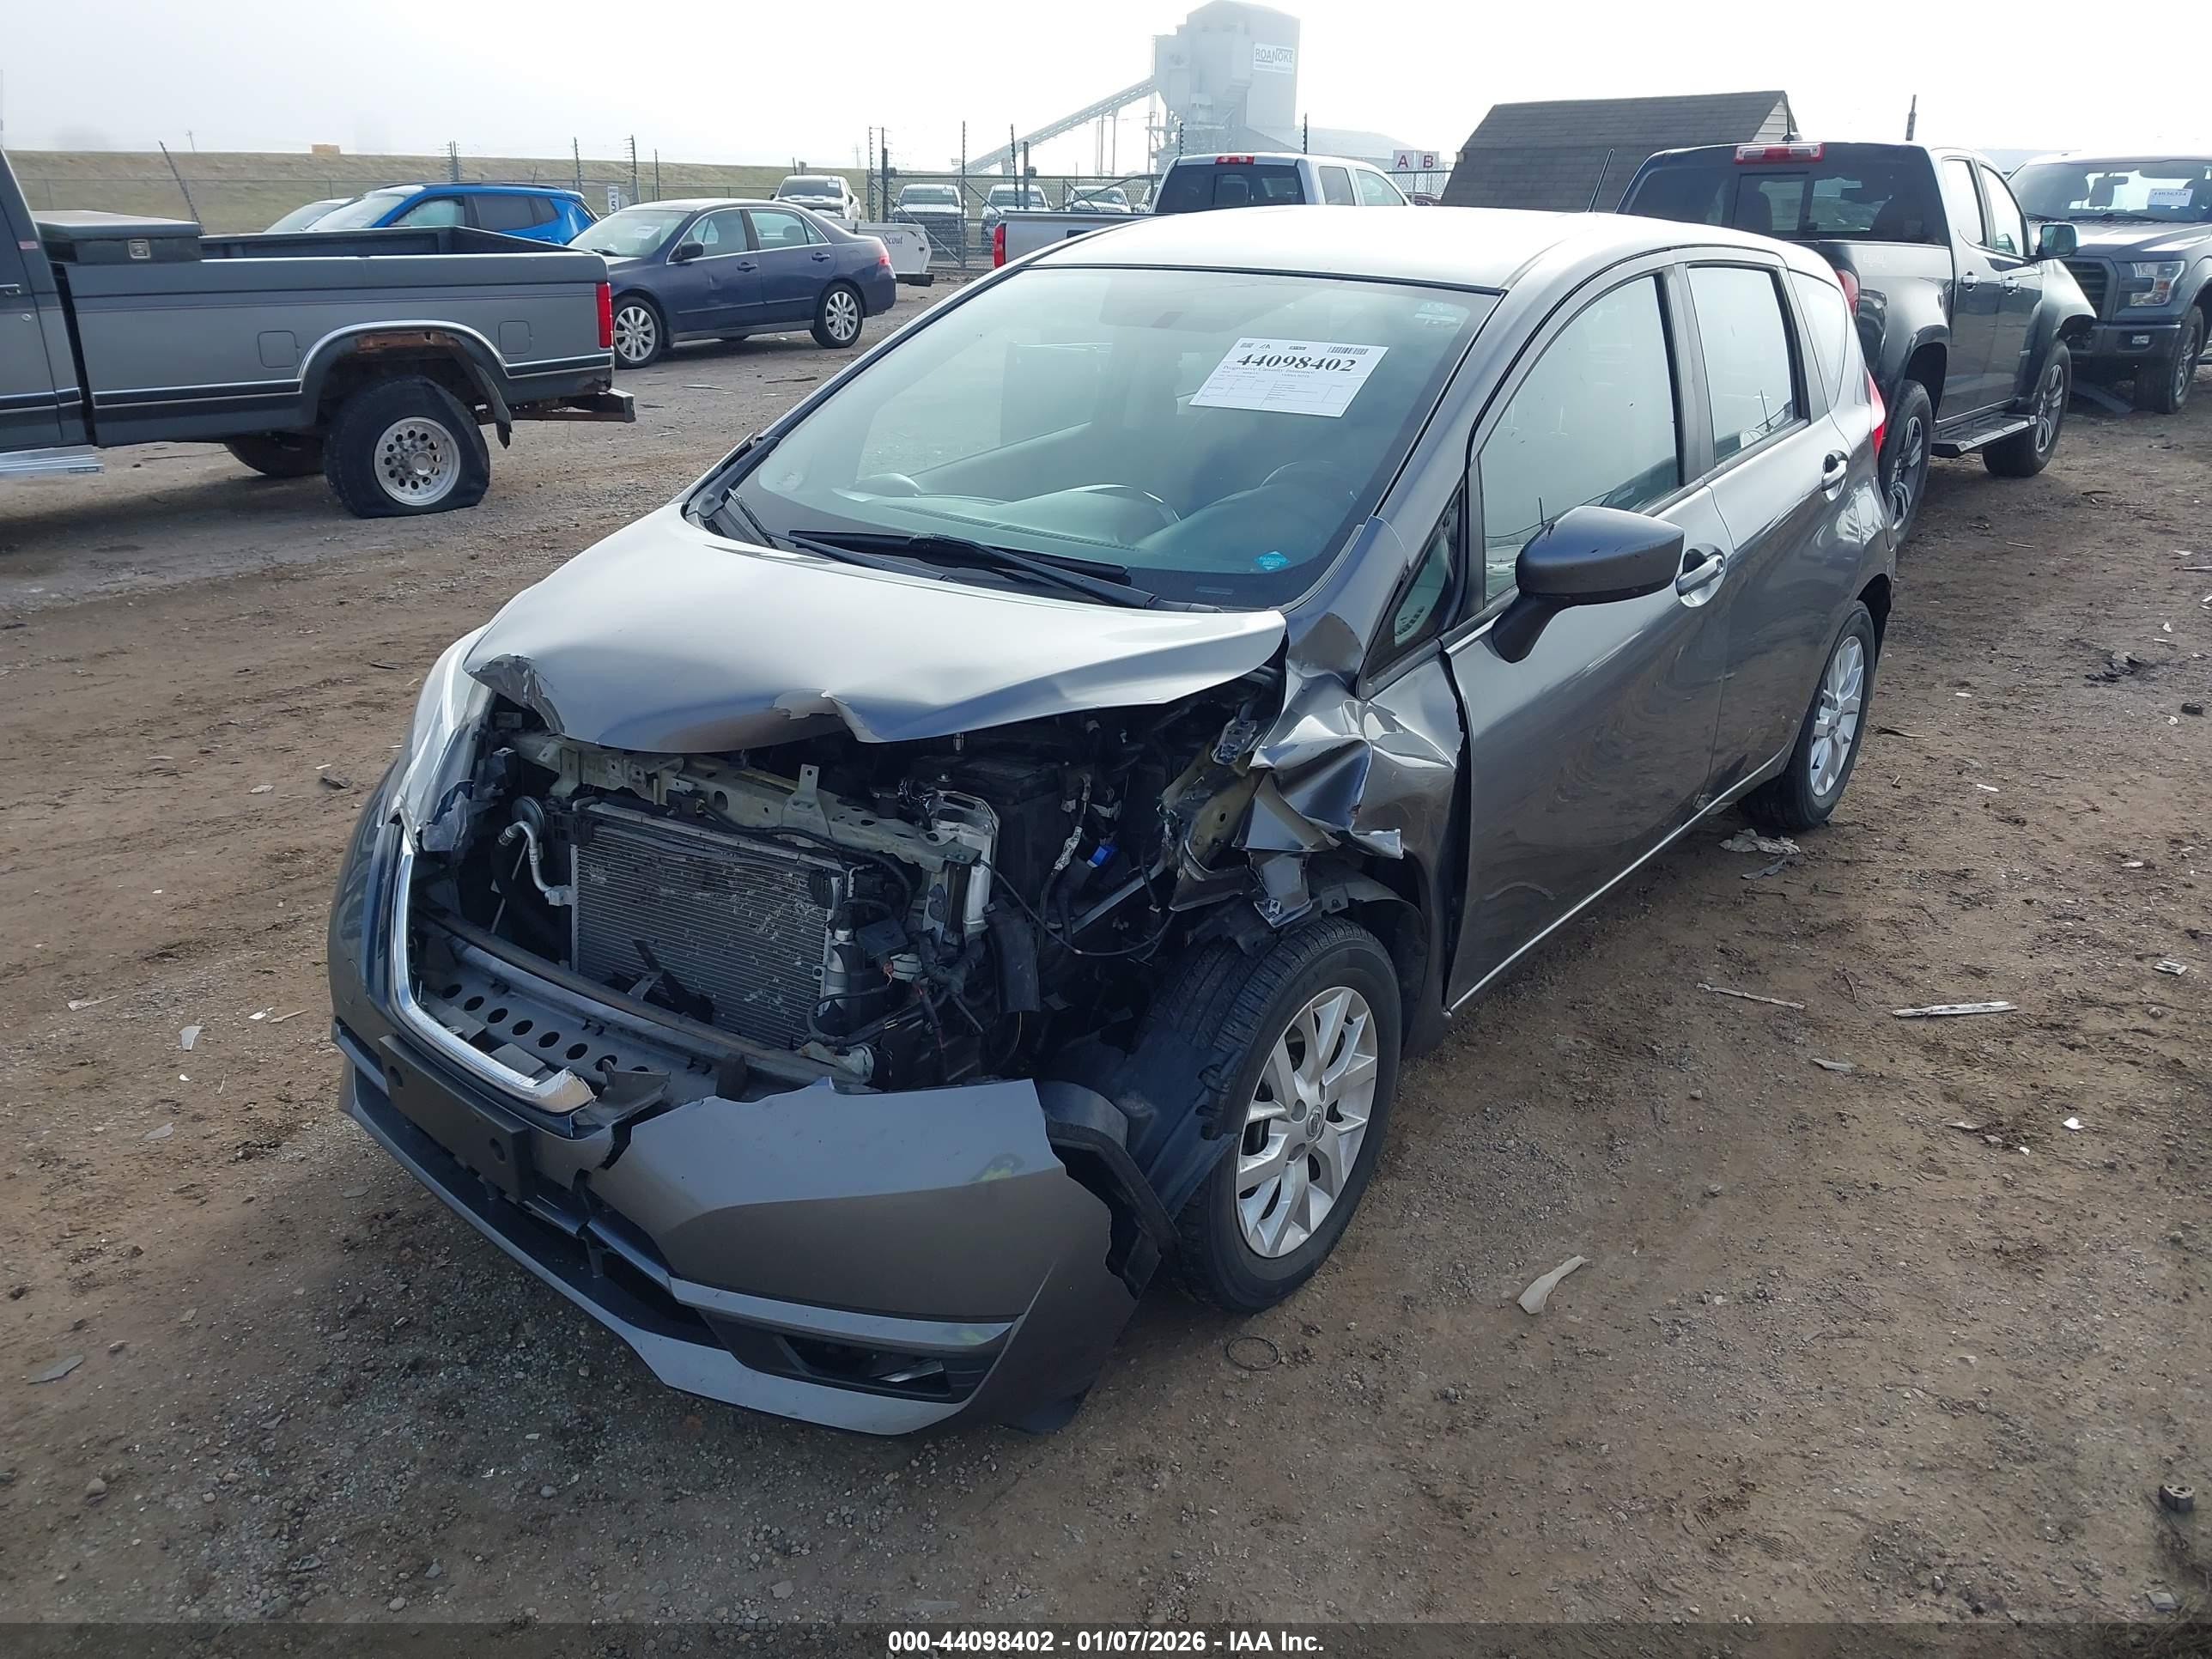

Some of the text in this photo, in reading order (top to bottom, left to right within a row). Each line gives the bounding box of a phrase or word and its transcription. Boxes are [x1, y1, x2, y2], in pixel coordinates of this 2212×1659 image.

[1255, 48, 1293, 64] ROANOKE
[1397, 155, 1408, 167] A
[1423, 155, 1433, 167] B
[611, 200, 617, 211] 5
[884, 232, 903, 245] Scout
[1236, 353, 1357, 373] 44098402
